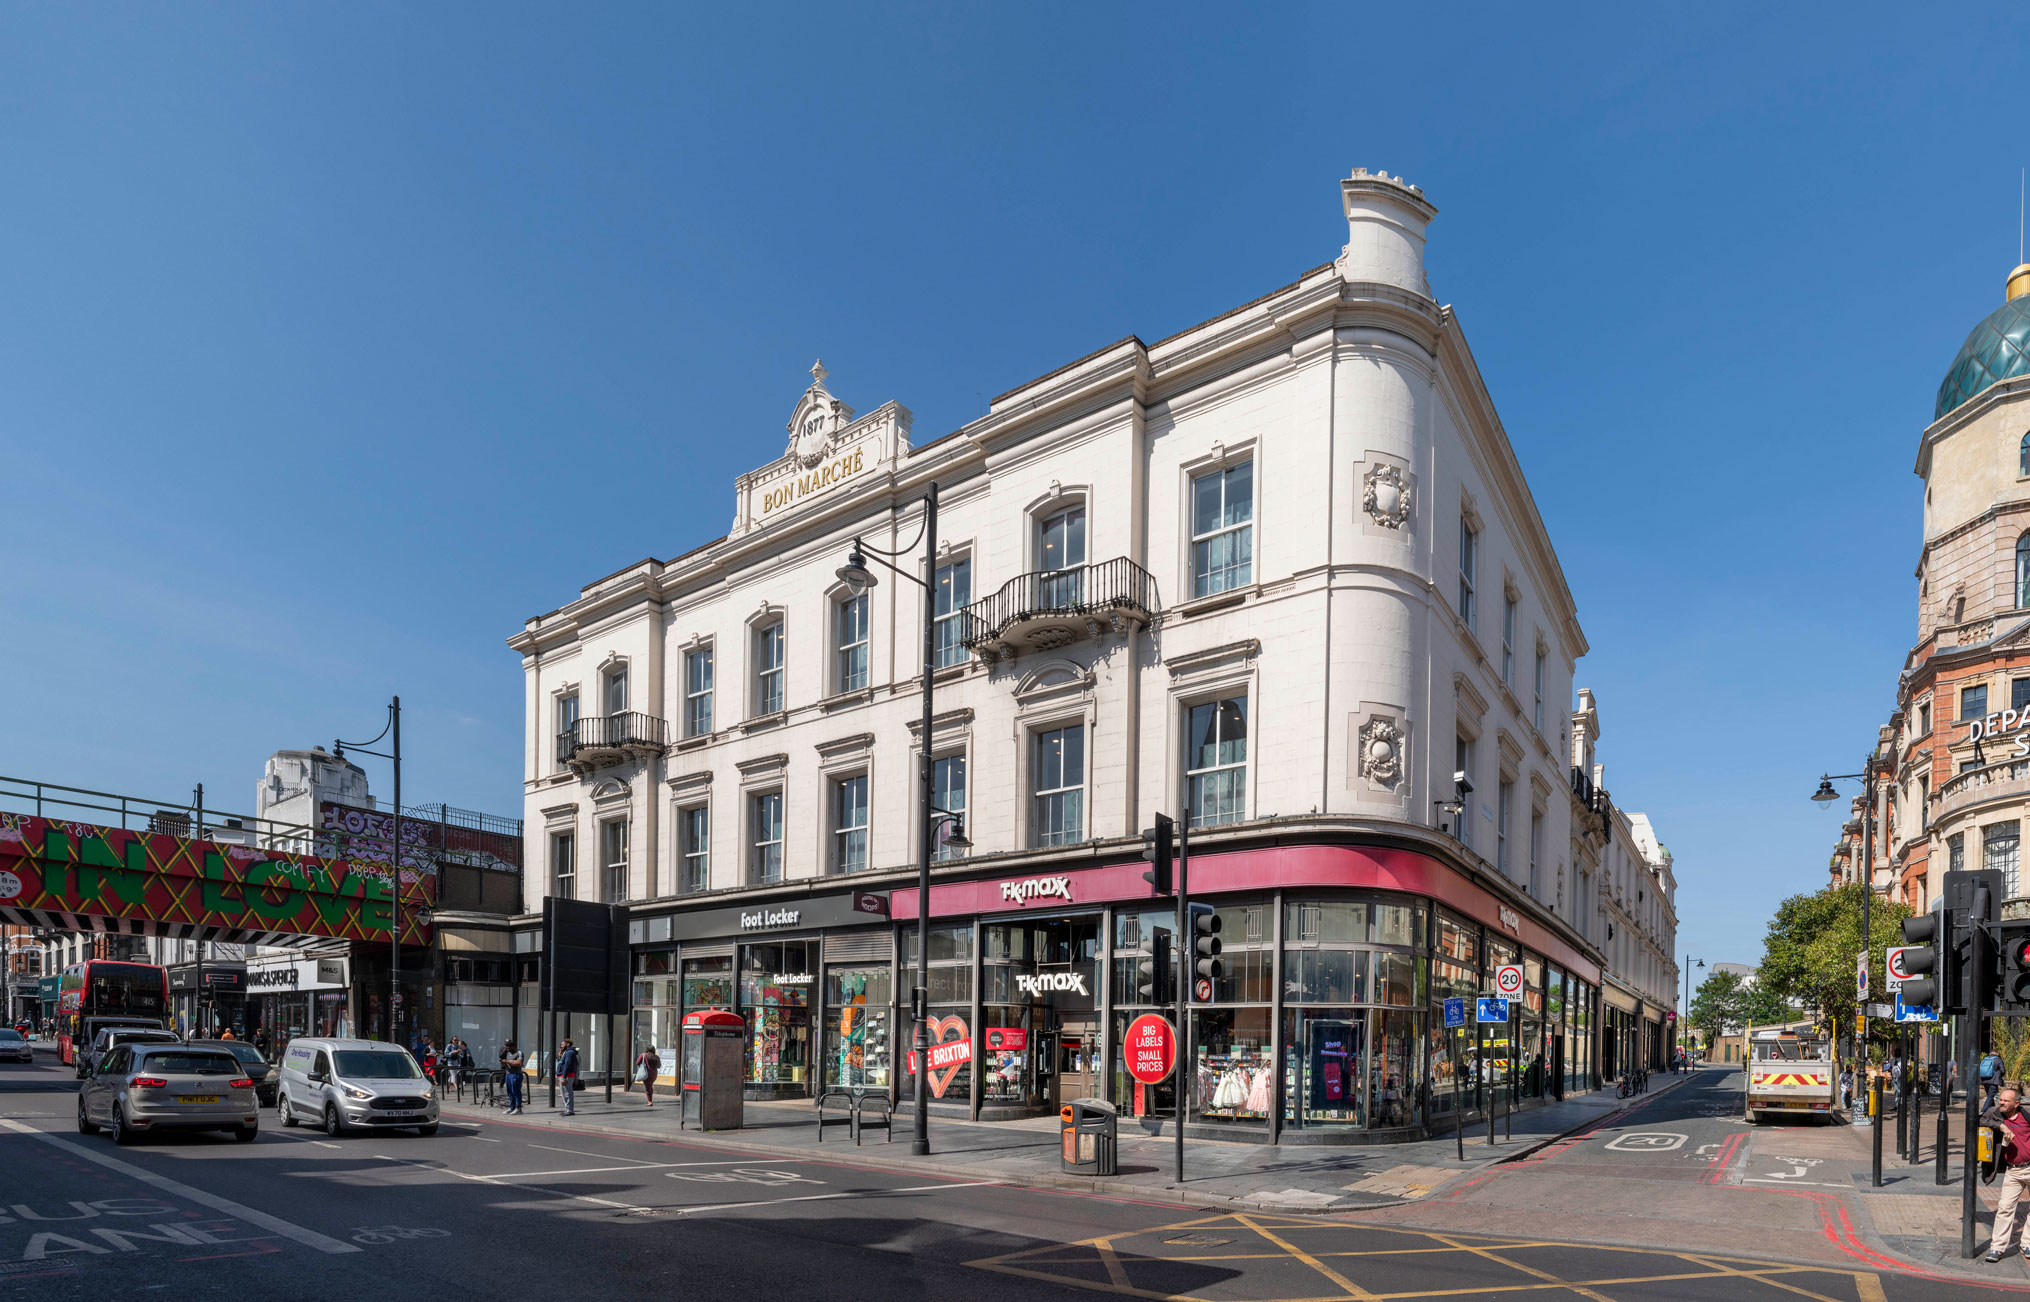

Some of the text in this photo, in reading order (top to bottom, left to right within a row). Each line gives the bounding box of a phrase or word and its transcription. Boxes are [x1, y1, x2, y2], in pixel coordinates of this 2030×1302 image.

[803, 415, 825, 438] 1877
[763, 445, 863, 513] BON MARCHÉ
[275, 860, 325, 882] COMFY
[204, 853, 398, 930] LOVE
[741, 908, 799, 928] Foot Locker
[321, 966, 338, 974] M&S
[773, 972, 812, 984] Foot Locker
[1502, 974, 1518, 985] 20
[1889, 981, 1902, 989] ZO
[1142, 1025, 1156, 1036] BIG
[1136, 1036, 1163, 1047] LABELS
[911, 1041, 970, 1071] LE BRIXTON
[1138, 1050, 1162, 1062] SMALL
[1137, 1061, 1164, 1072] PRICES
[1624, 1136, 1675, 1146] 20
[0, 1199, 180, 1225] US
[22, 1218, 281, 1261] ANE
